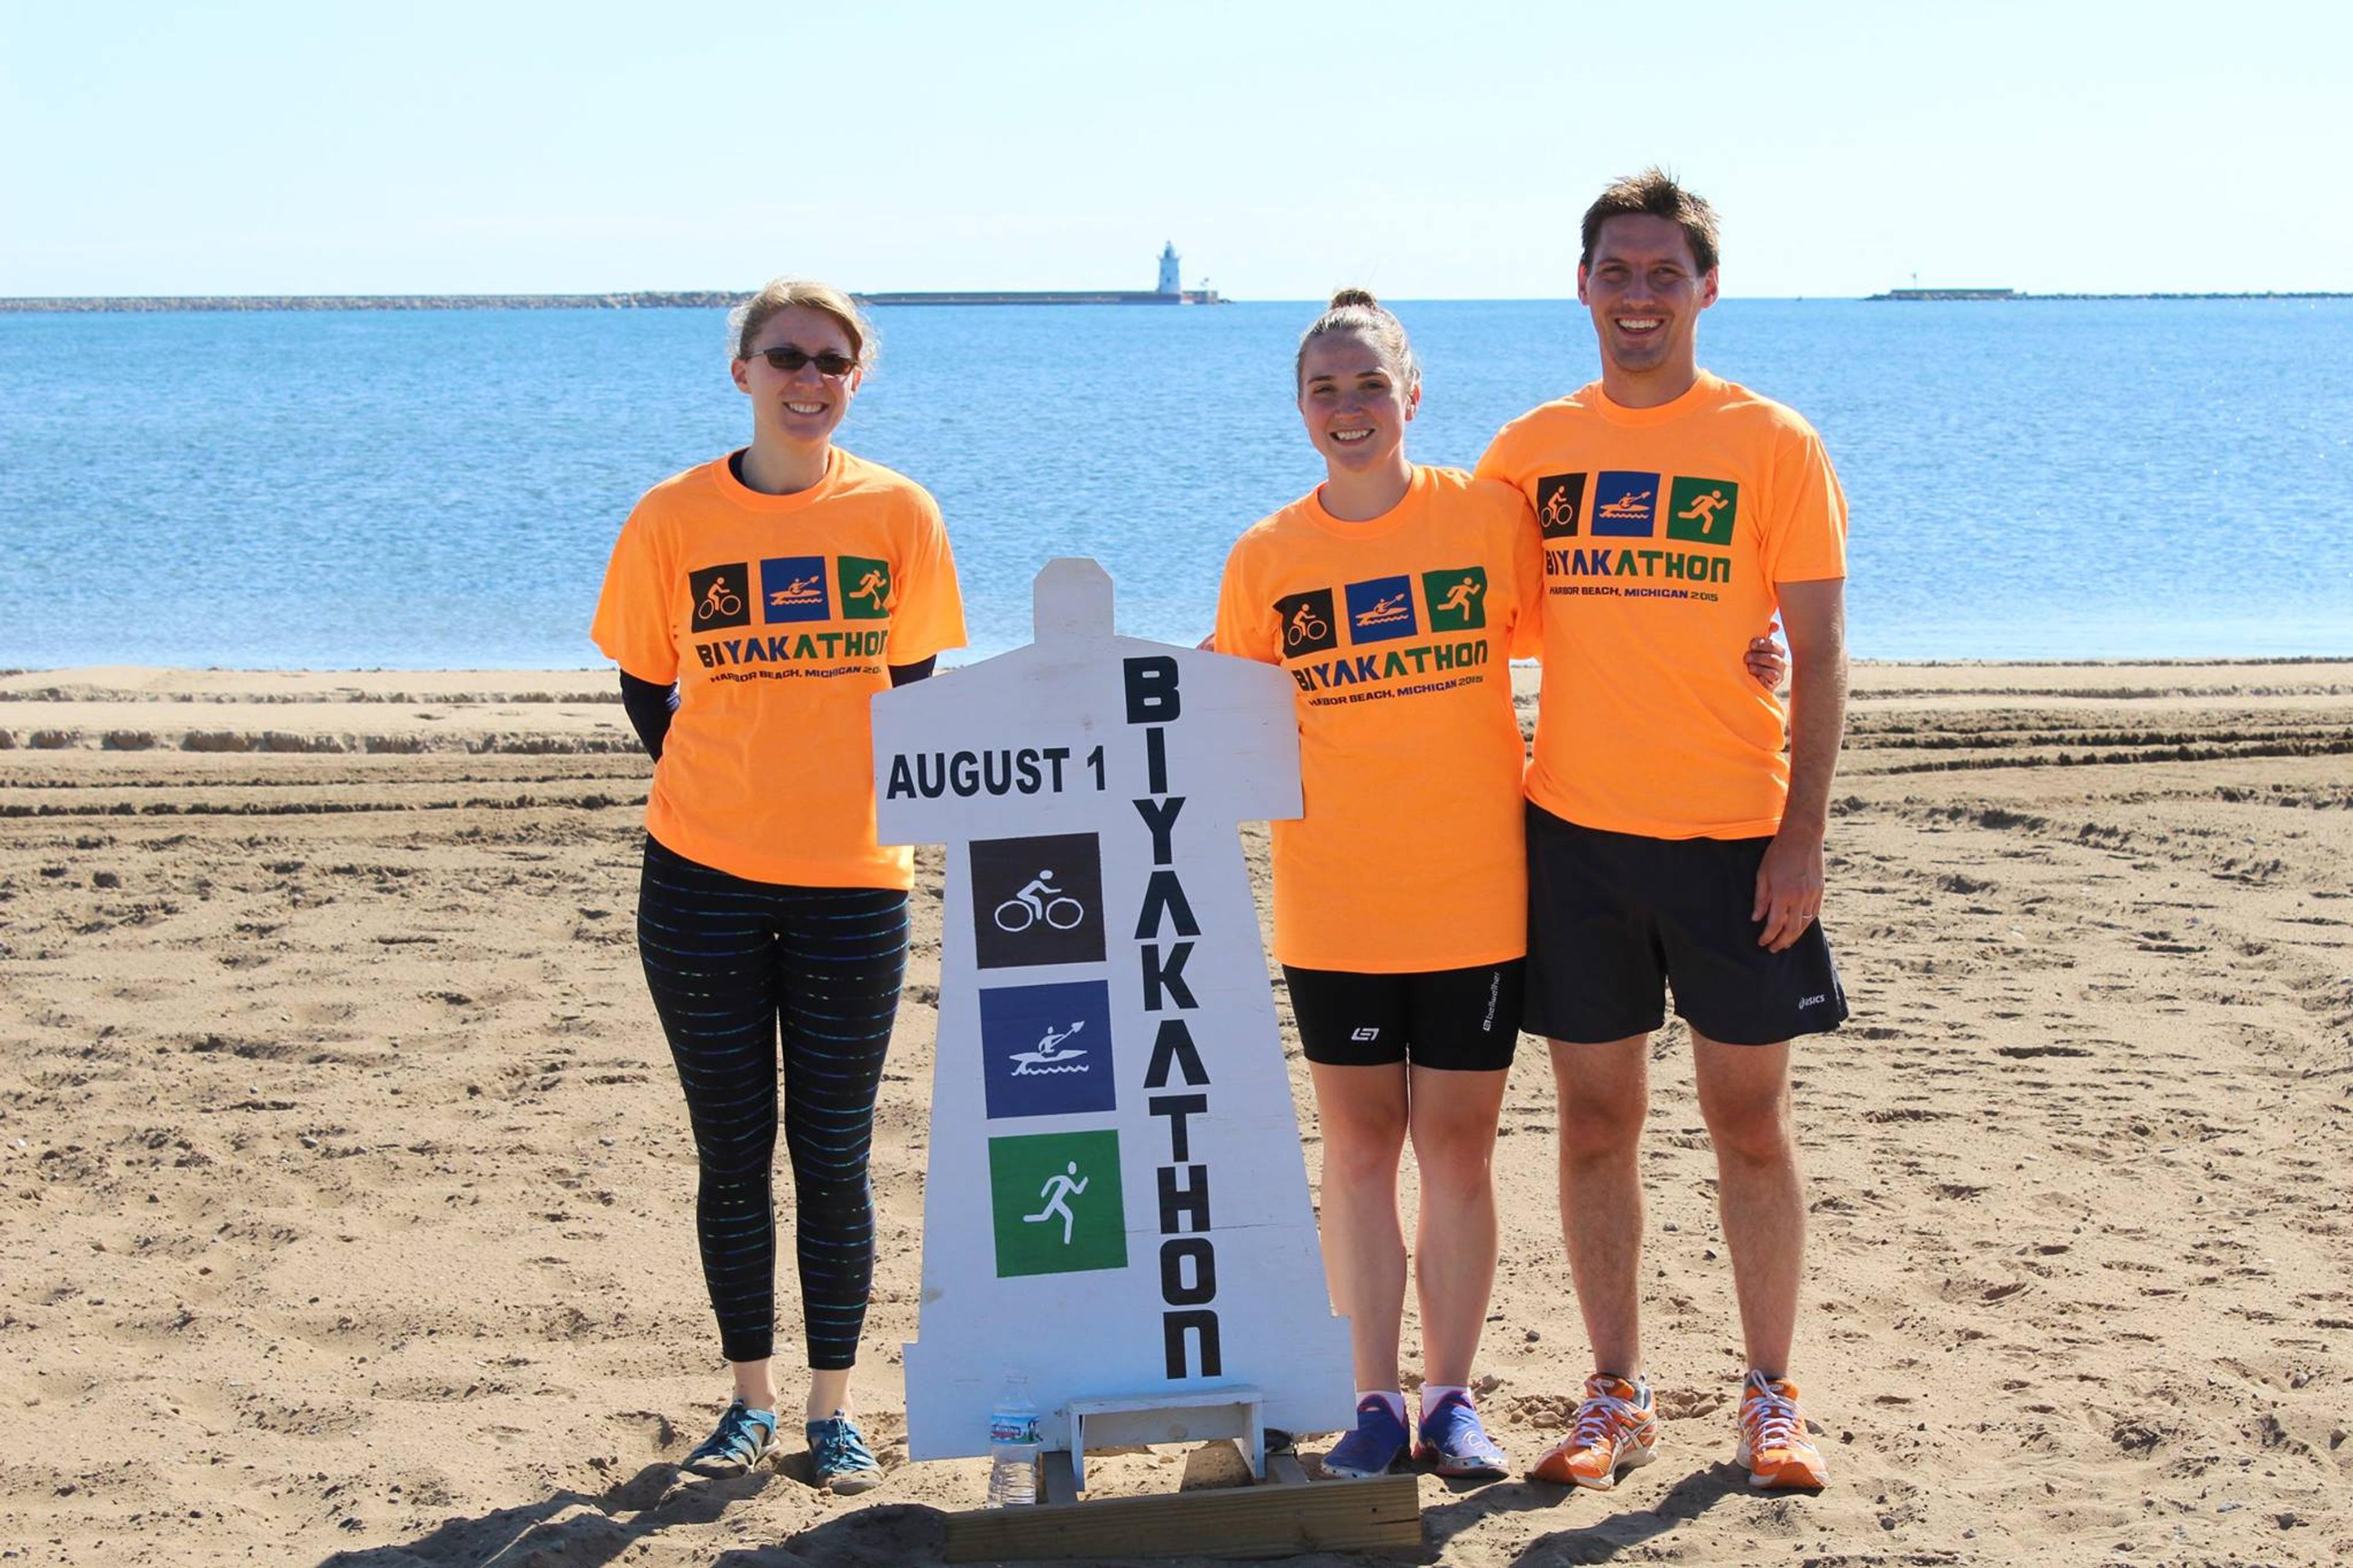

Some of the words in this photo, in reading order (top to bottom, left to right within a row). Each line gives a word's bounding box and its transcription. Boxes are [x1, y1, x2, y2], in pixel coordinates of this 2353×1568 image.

[1545, 549, 1731, 583] BIYAKATHON
[1549, 586, 1579, 595] HARBOR
[1582, 586, 1622, 597] BEACH,
[1624, 588, 1688, 599] MICHIGAN
[1690, 591, 1718, 602] 2015
[711, 672, 757, 683] HARBOR
[759, 669, 802, 679] BEACH,
[805, 666, 862, 678] MICHIGAN
[1291, 639, 1488, 692] BIYAKATHON
[1349, 689, 1395, 703] BEACH,
[1397, 679, 1457, 696] MICHIGAN
[1458, 675, 1484, 686] 2015
[886, 748, 1070, 799] AUGUST
[1086, 745, 1105, 791] 1
[1123, 656, 1222, 1380] BIYAKATHON
